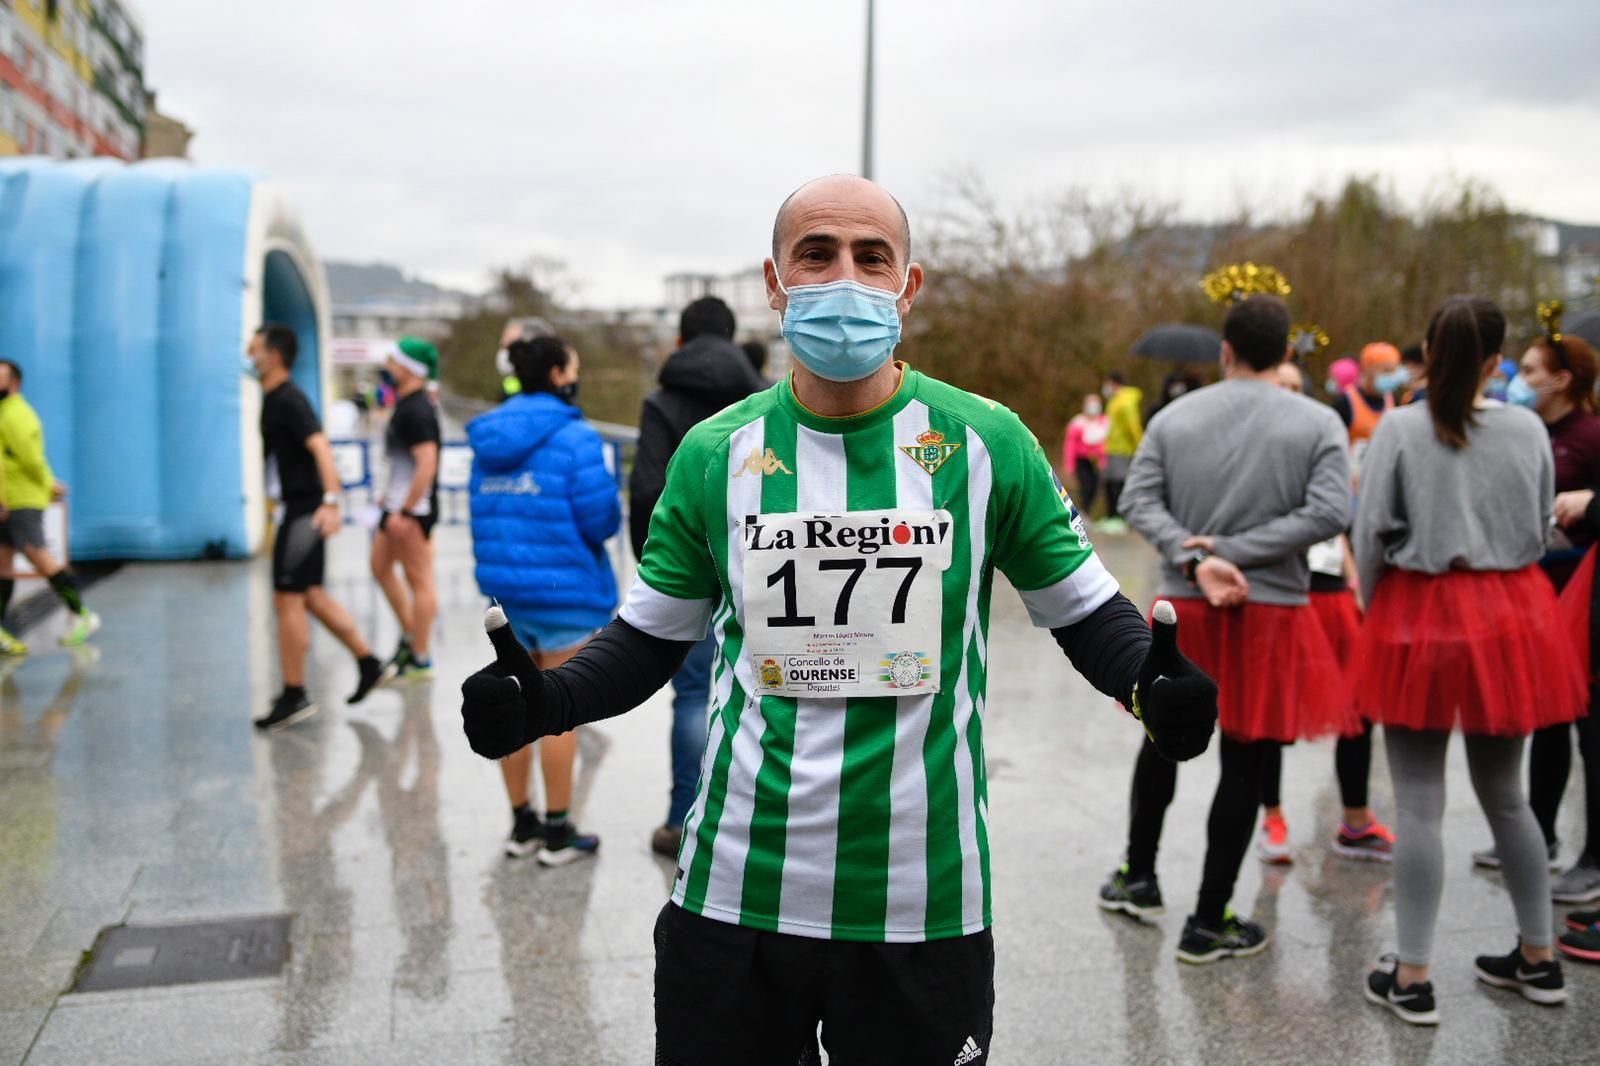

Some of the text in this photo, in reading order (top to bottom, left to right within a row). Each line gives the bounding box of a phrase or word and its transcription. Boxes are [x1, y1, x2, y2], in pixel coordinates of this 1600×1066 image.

[748, 524, 797, 551] La
[767, 556, 923, 627] 177
[788, 656, 845, 667] Concello de
[789, 668, 856, 681] OURENSE
[954, 1047, 983, 1066] adidas
